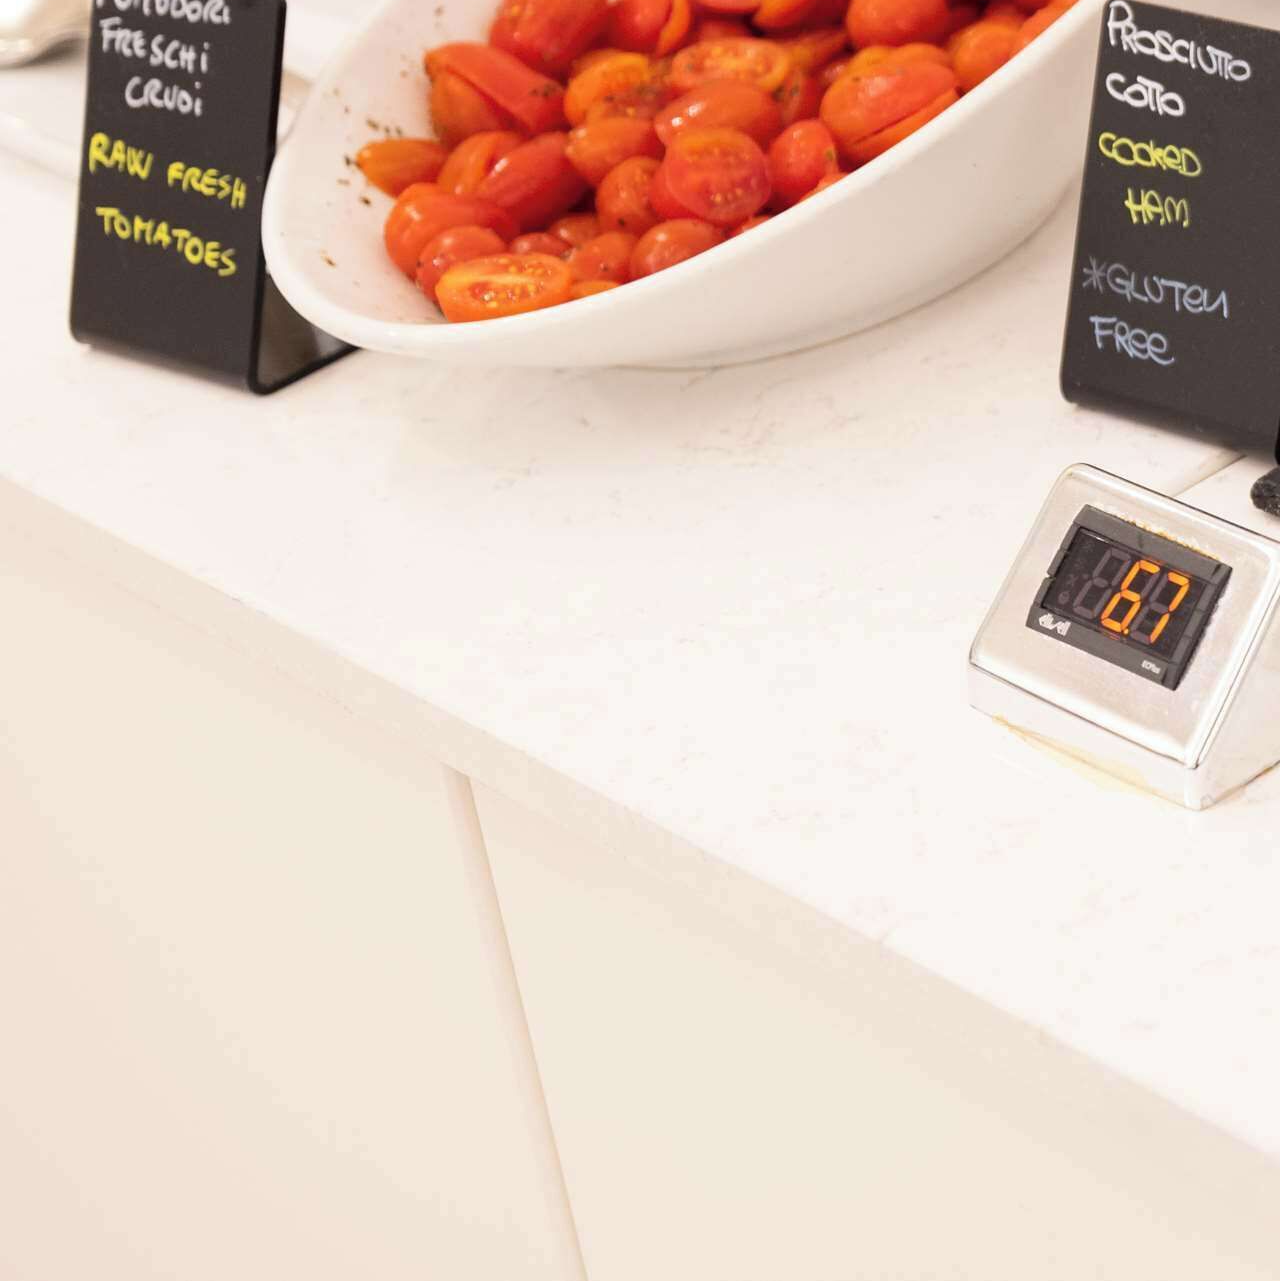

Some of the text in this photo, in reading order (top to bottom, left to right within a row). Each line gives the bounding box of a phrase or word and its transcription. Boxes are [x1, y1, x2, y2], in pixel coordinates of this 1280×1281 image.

[1106, 0, 1252, 83] PROSCIUTTO
[1105, 72, 1186, 117] COTTO
[89, 131, 247, 209] RAW FRESH
[95, 206, 237, 277] TOMATOES
[1124, 187, 1190, 228] HAM
